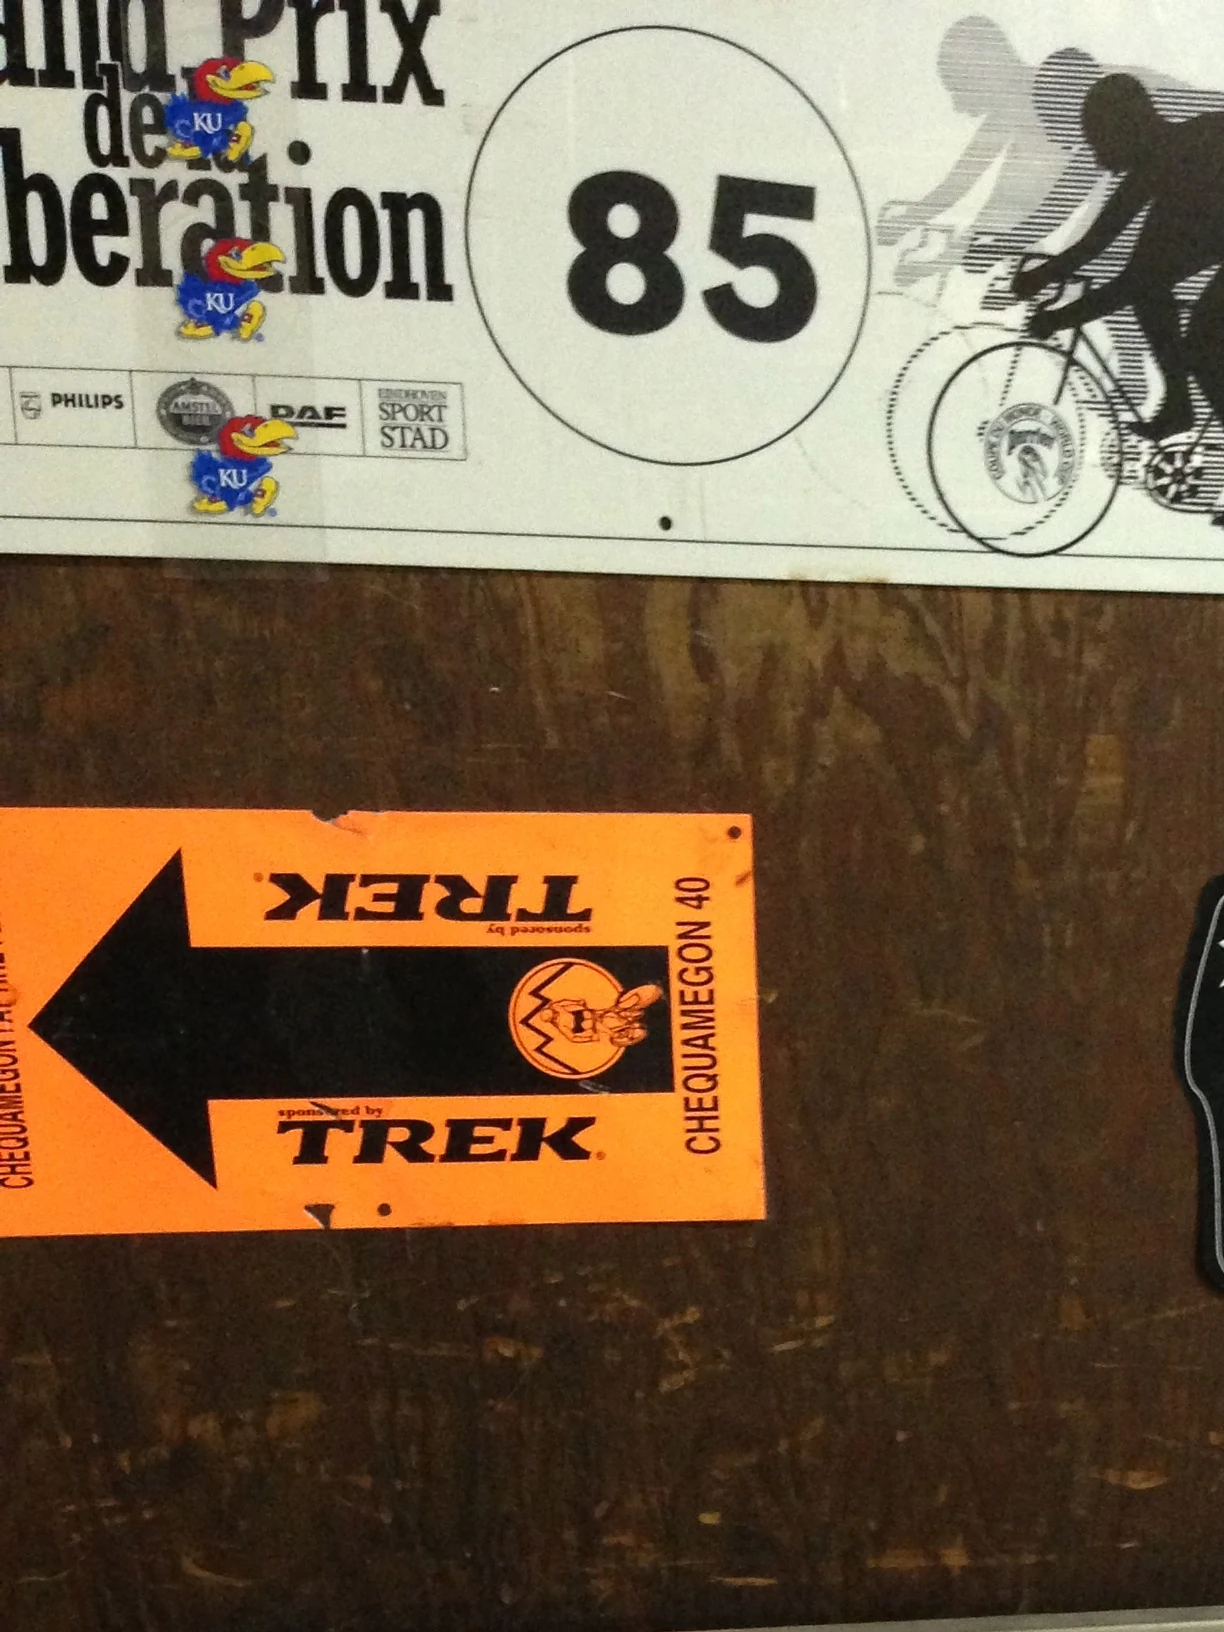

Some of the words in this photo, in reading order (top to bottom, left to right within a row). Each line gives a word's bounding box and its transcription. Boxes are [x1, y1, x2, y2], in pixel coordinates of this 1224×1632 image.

[83, 63, 168, 168] de
[193, 112, 223, 135] KU
[567, 170, 818, 343] 85
[205, 292, 236, 314] KU
[51, 393, 124, 410] PHILIPS
[270, 404, 346, 421] DAF
[379, 402, 448, 422] SPORT
[381, 425, 449, 450] STAD
[219, 467, 249, 490] KU
[263, 872, 593, 922] TREK
[674, 876, 712, 911] 40
[486, 923, 506, 935] by
[510, 923, 591, 935] sponsored
[676, 921, 722, 1156] CHEQUAMEGON
[365, 1104, 384, 1118] by
[276, 1116, 597, 1165] TREK
